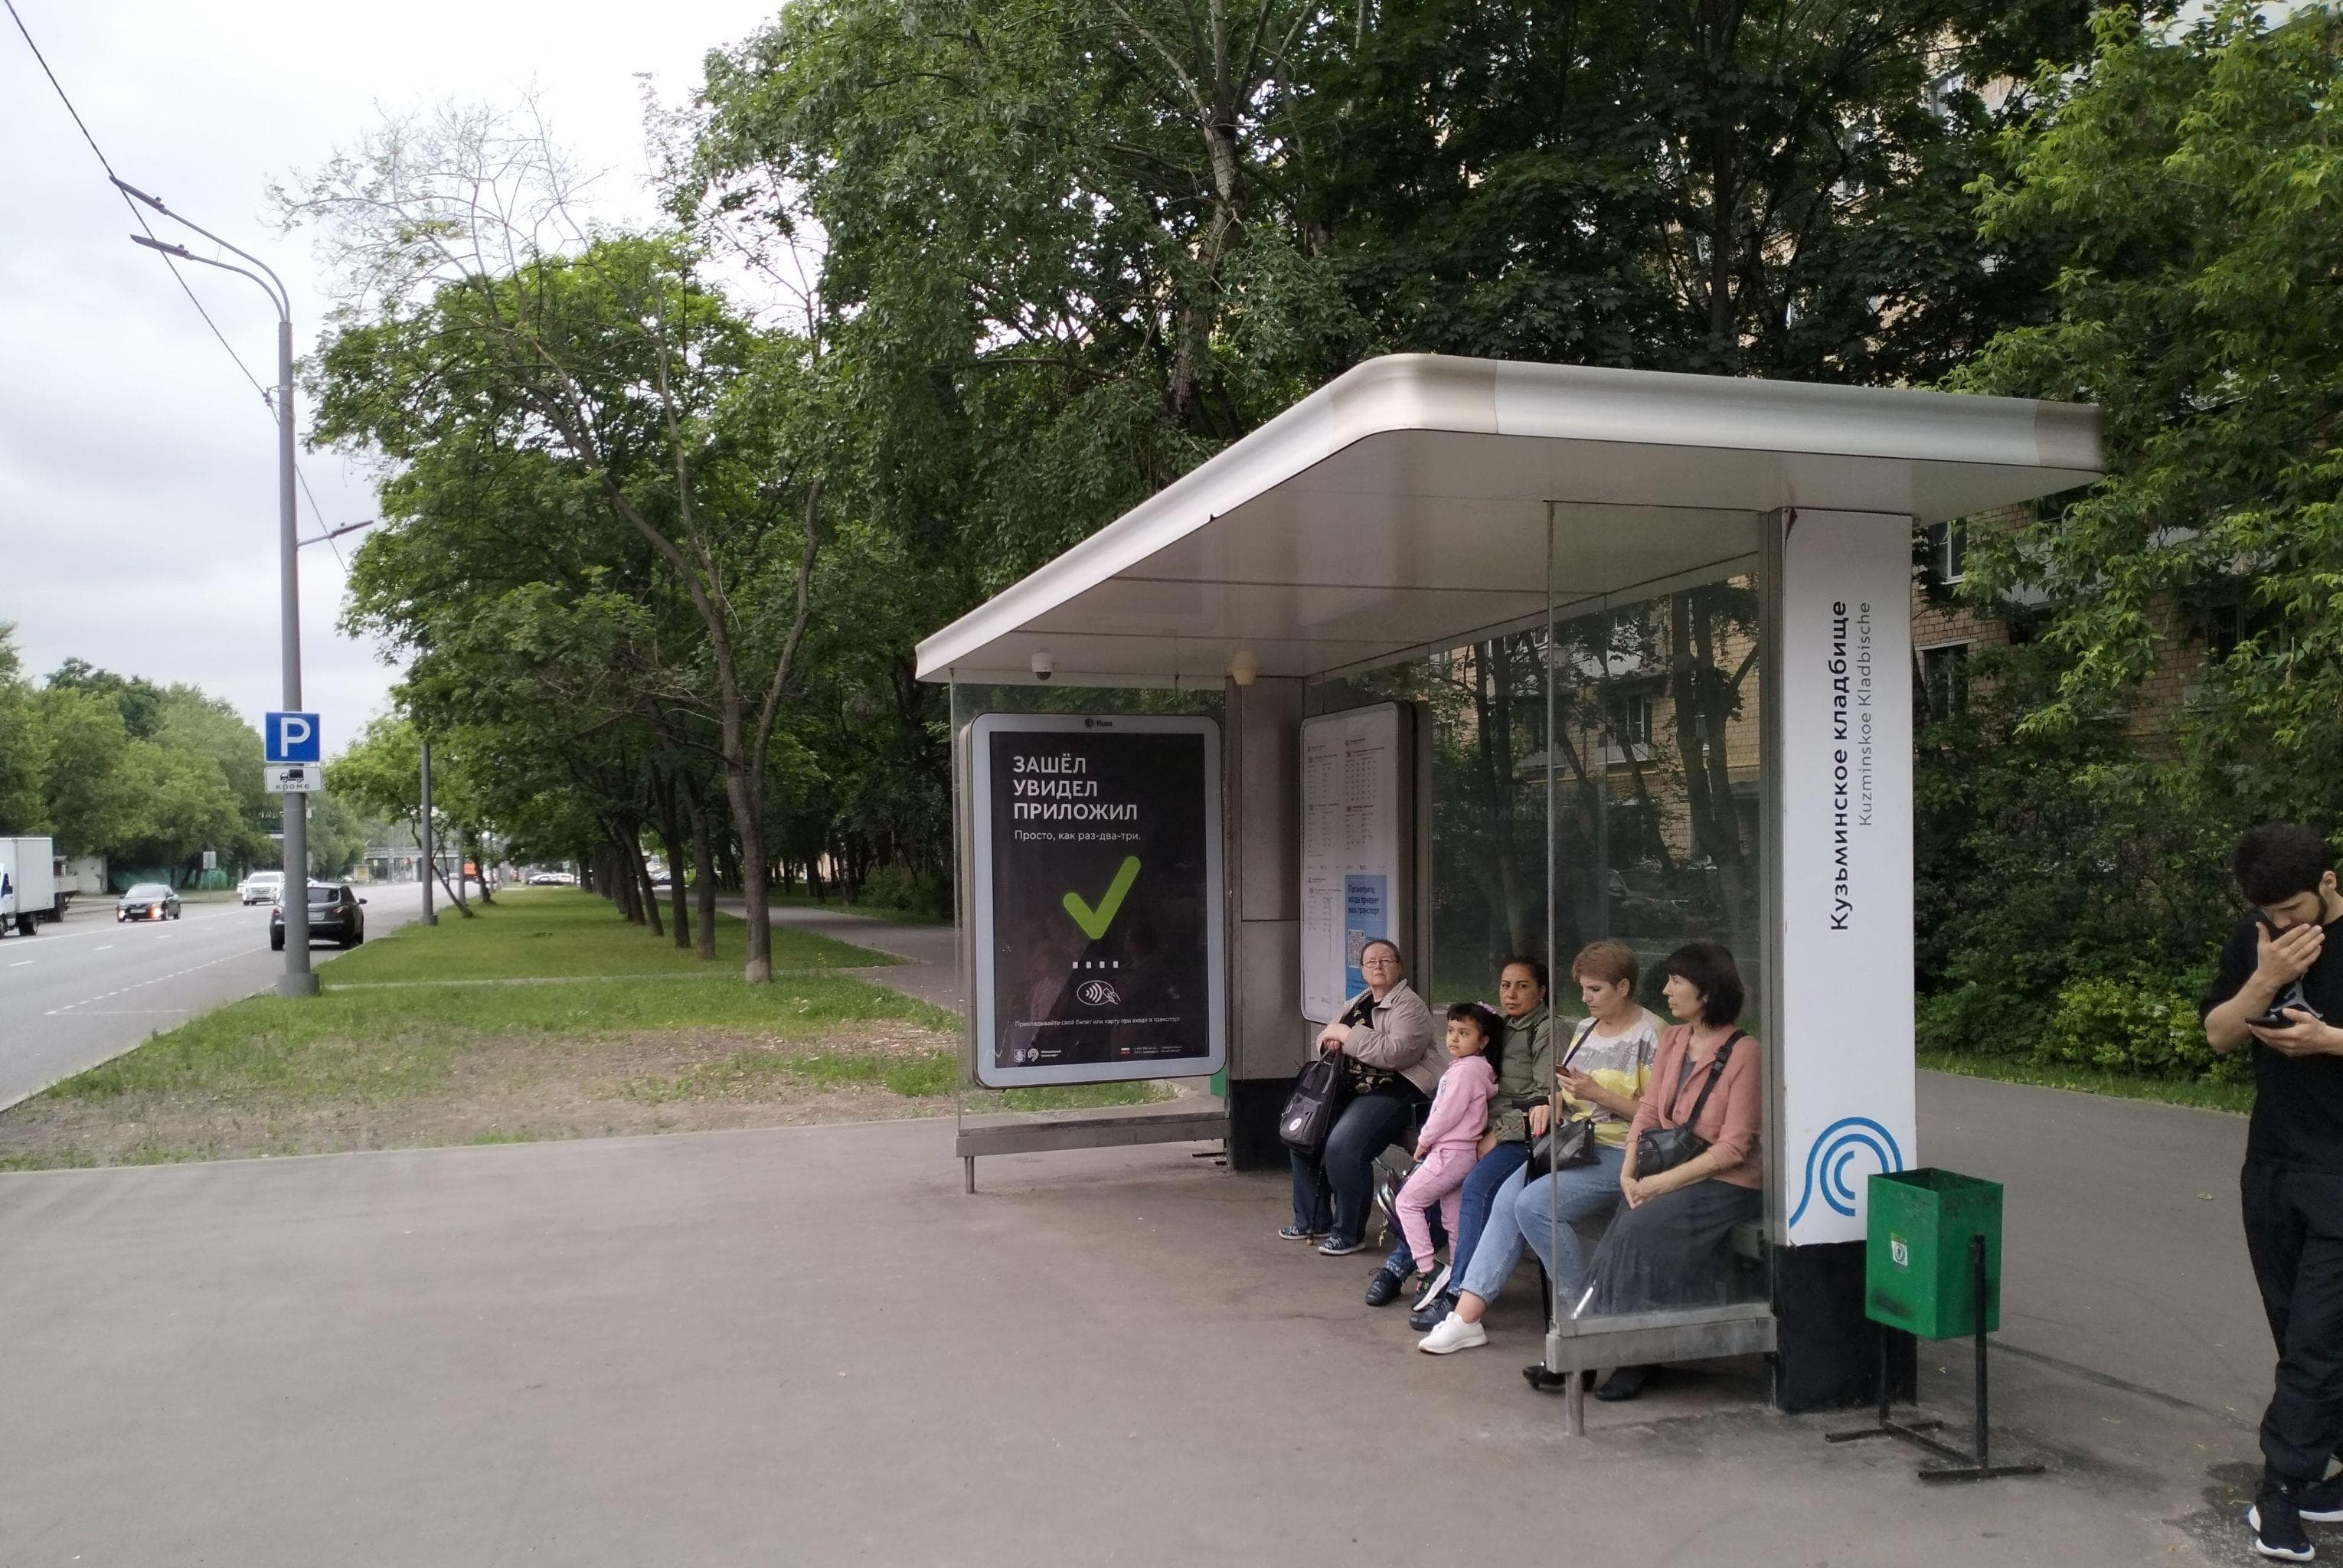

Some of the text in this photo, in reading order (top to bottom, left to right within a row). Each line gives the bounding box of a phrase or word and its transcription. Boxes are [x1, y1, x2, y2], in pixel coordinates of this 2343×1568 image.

[1857, 603, 1872, 825] Kuzminskoe Kladbische
[280, 717, 311, 757] P
[1013, 753, 1086, 773] ЗАШЁЛ
[1828, 601, 1853, 930] Кузьминское кладбище
[1013, 779, 1097, 799] УВИДЕЛ
[1014, 802, 1138, 820] ПРИЛОЖИЛ
[1015, 830, 1056, 841] Просто,
[1078, 832, 1141, 841] раз-два-три.
